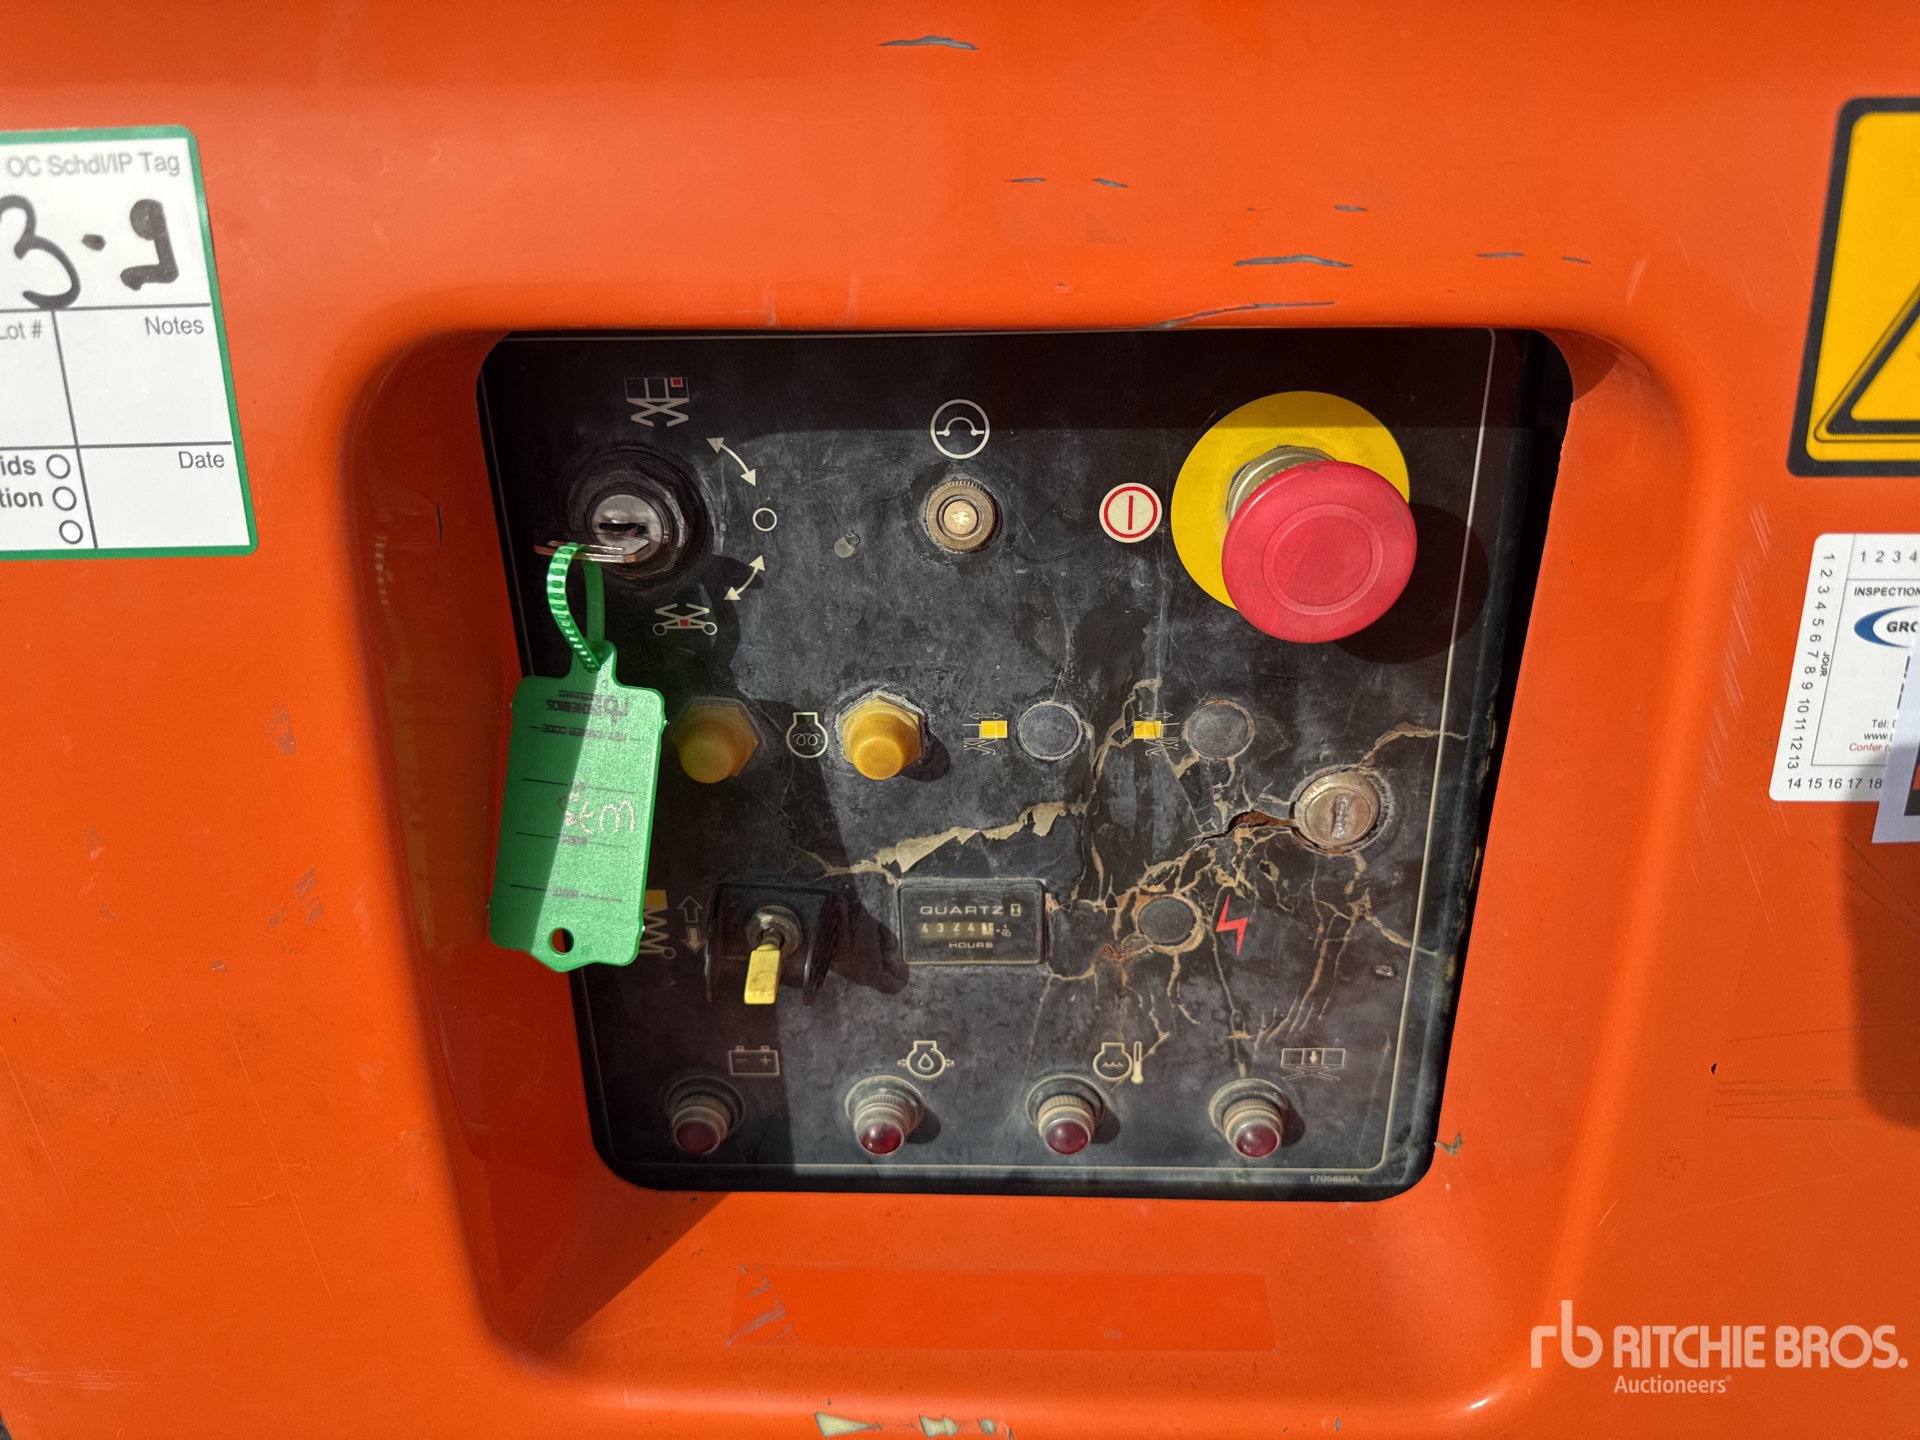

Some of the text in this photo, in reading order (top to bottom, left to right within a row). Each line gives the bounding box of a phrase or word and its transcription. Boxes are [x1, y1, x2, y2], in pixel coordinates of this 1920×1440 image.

[6, 155, 42, 178] OC
[138, 152, 181, 177] Tag
[144, 316, 205, 337] Notes
[178, 450, 226, 471] Date
[1875, 550, 1885, 563] 2
[1892, 550, 1901, 563] 3
[1819, 651, 1830, 677] JOUR
[1849, 742, 1882, 752] Confer
[1787, 778, 1883, 789] 14 15 16 17 18
[920, 905, 1004, 915] QUARTZ
[948, 941, 994, 949] HOURS
